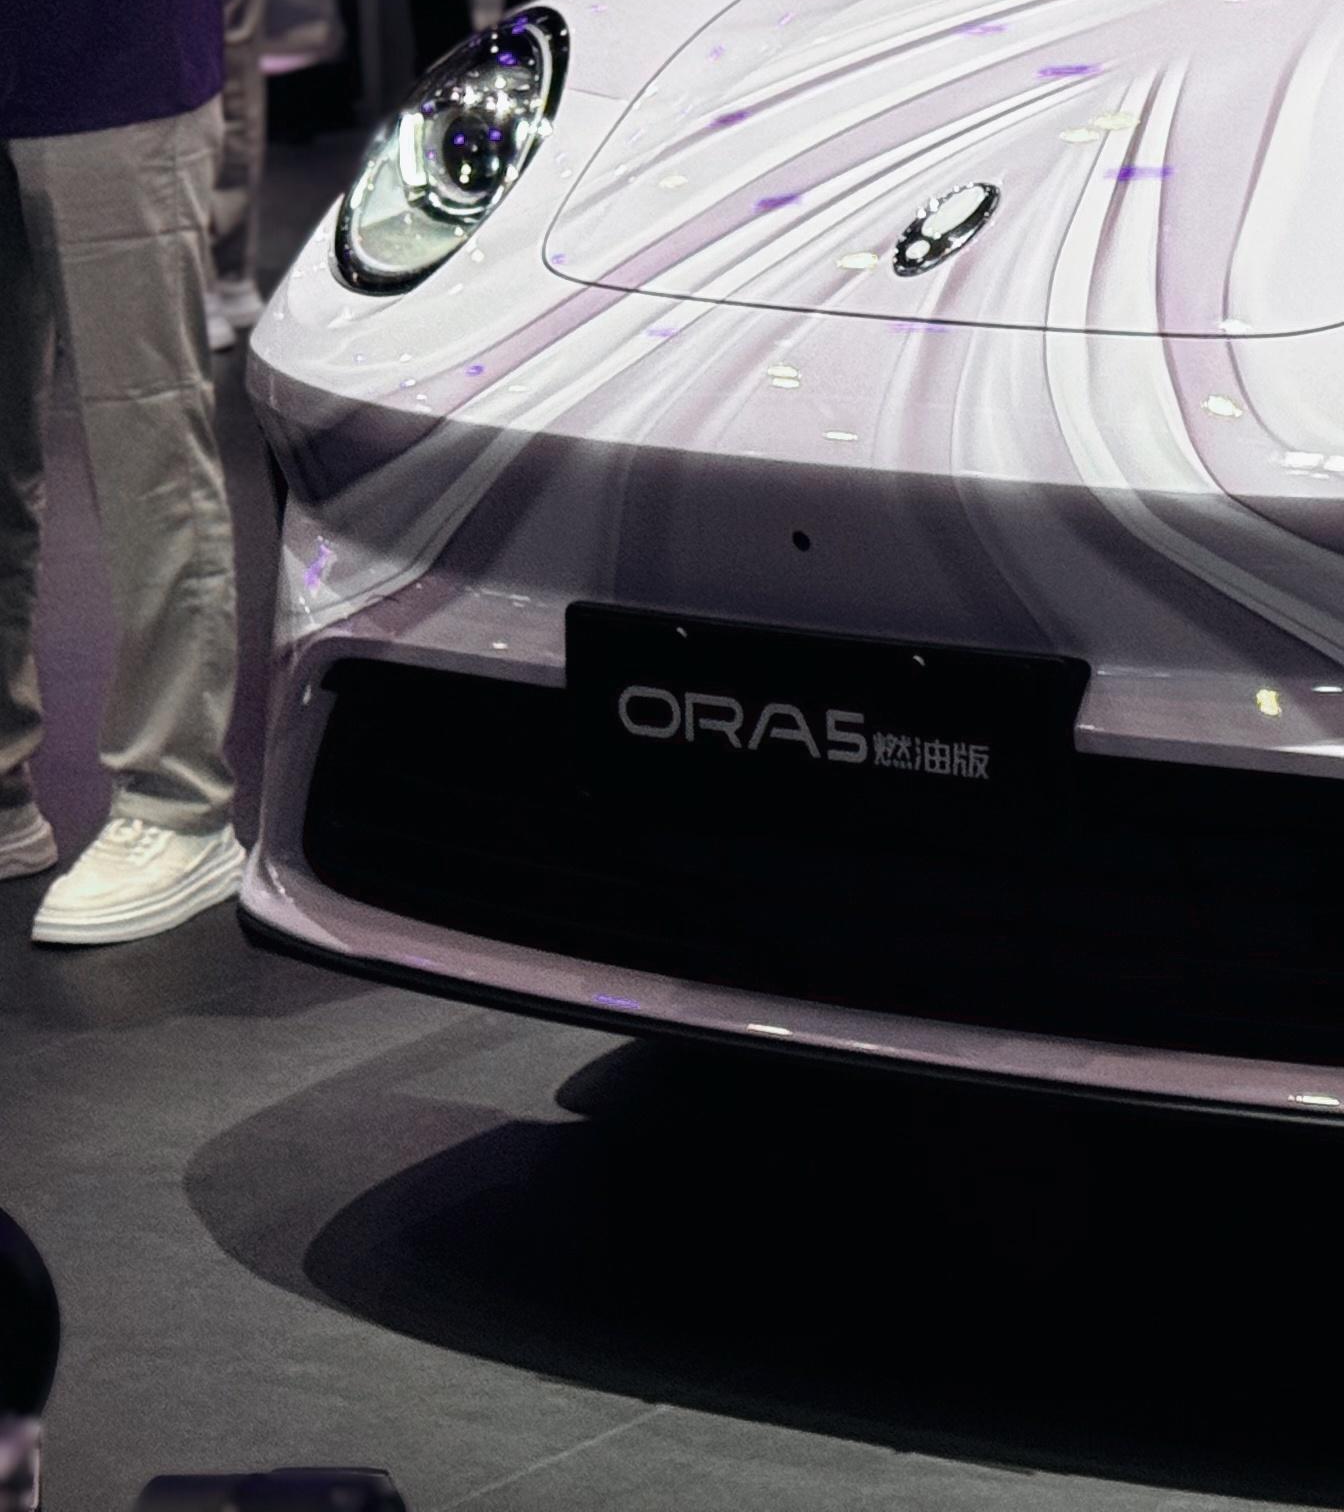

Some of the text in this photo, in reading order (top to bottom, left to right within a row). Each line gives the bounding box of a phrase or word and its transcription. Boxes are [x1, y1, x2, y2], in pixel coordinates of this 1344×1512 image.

[618, 684, 990, 780] ORA5 燃油版
